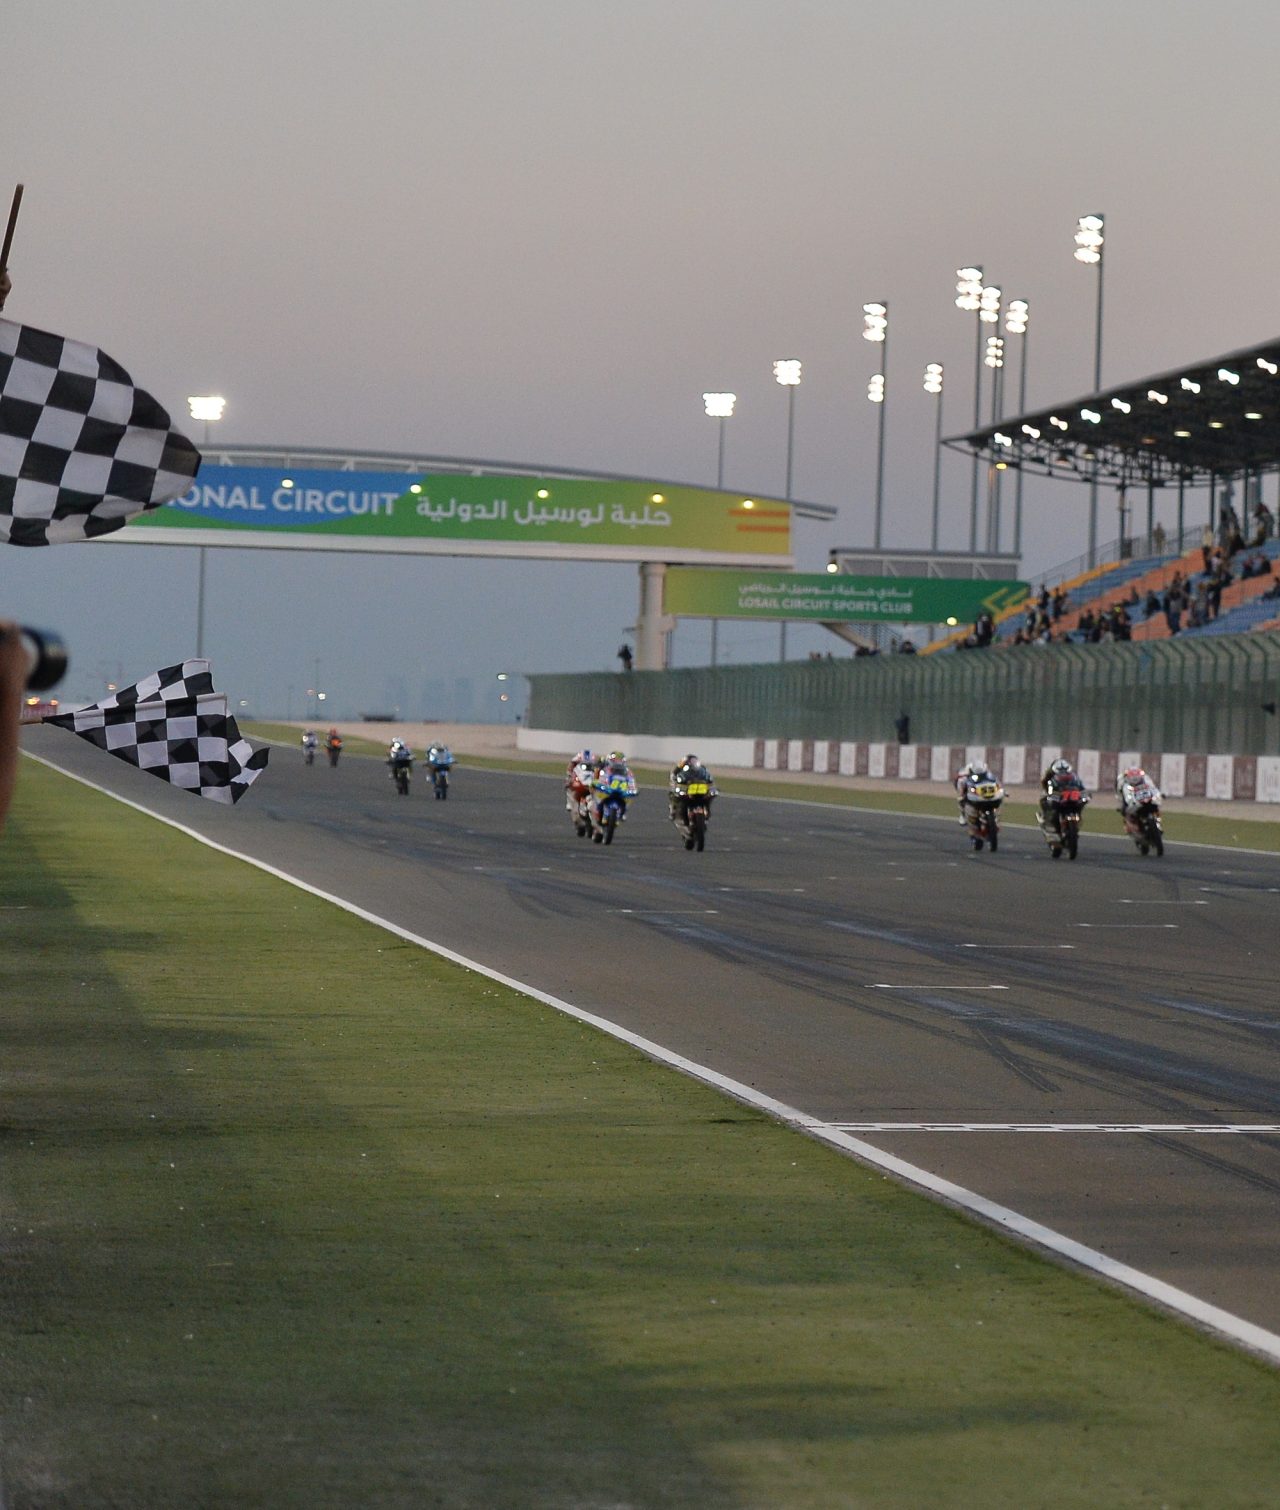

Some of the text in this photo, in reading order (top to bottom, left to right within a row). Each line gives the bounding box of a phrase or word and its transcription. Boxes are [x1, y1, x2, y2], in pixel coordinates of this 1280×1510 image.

[272, 488, 399, 516] CIRCUIT
[416, 496, 672, 528] حلبة لوسيل الدولية
[738, 597, 913, 614] LOSAIL CIRCUIT SPORTS CLUB
